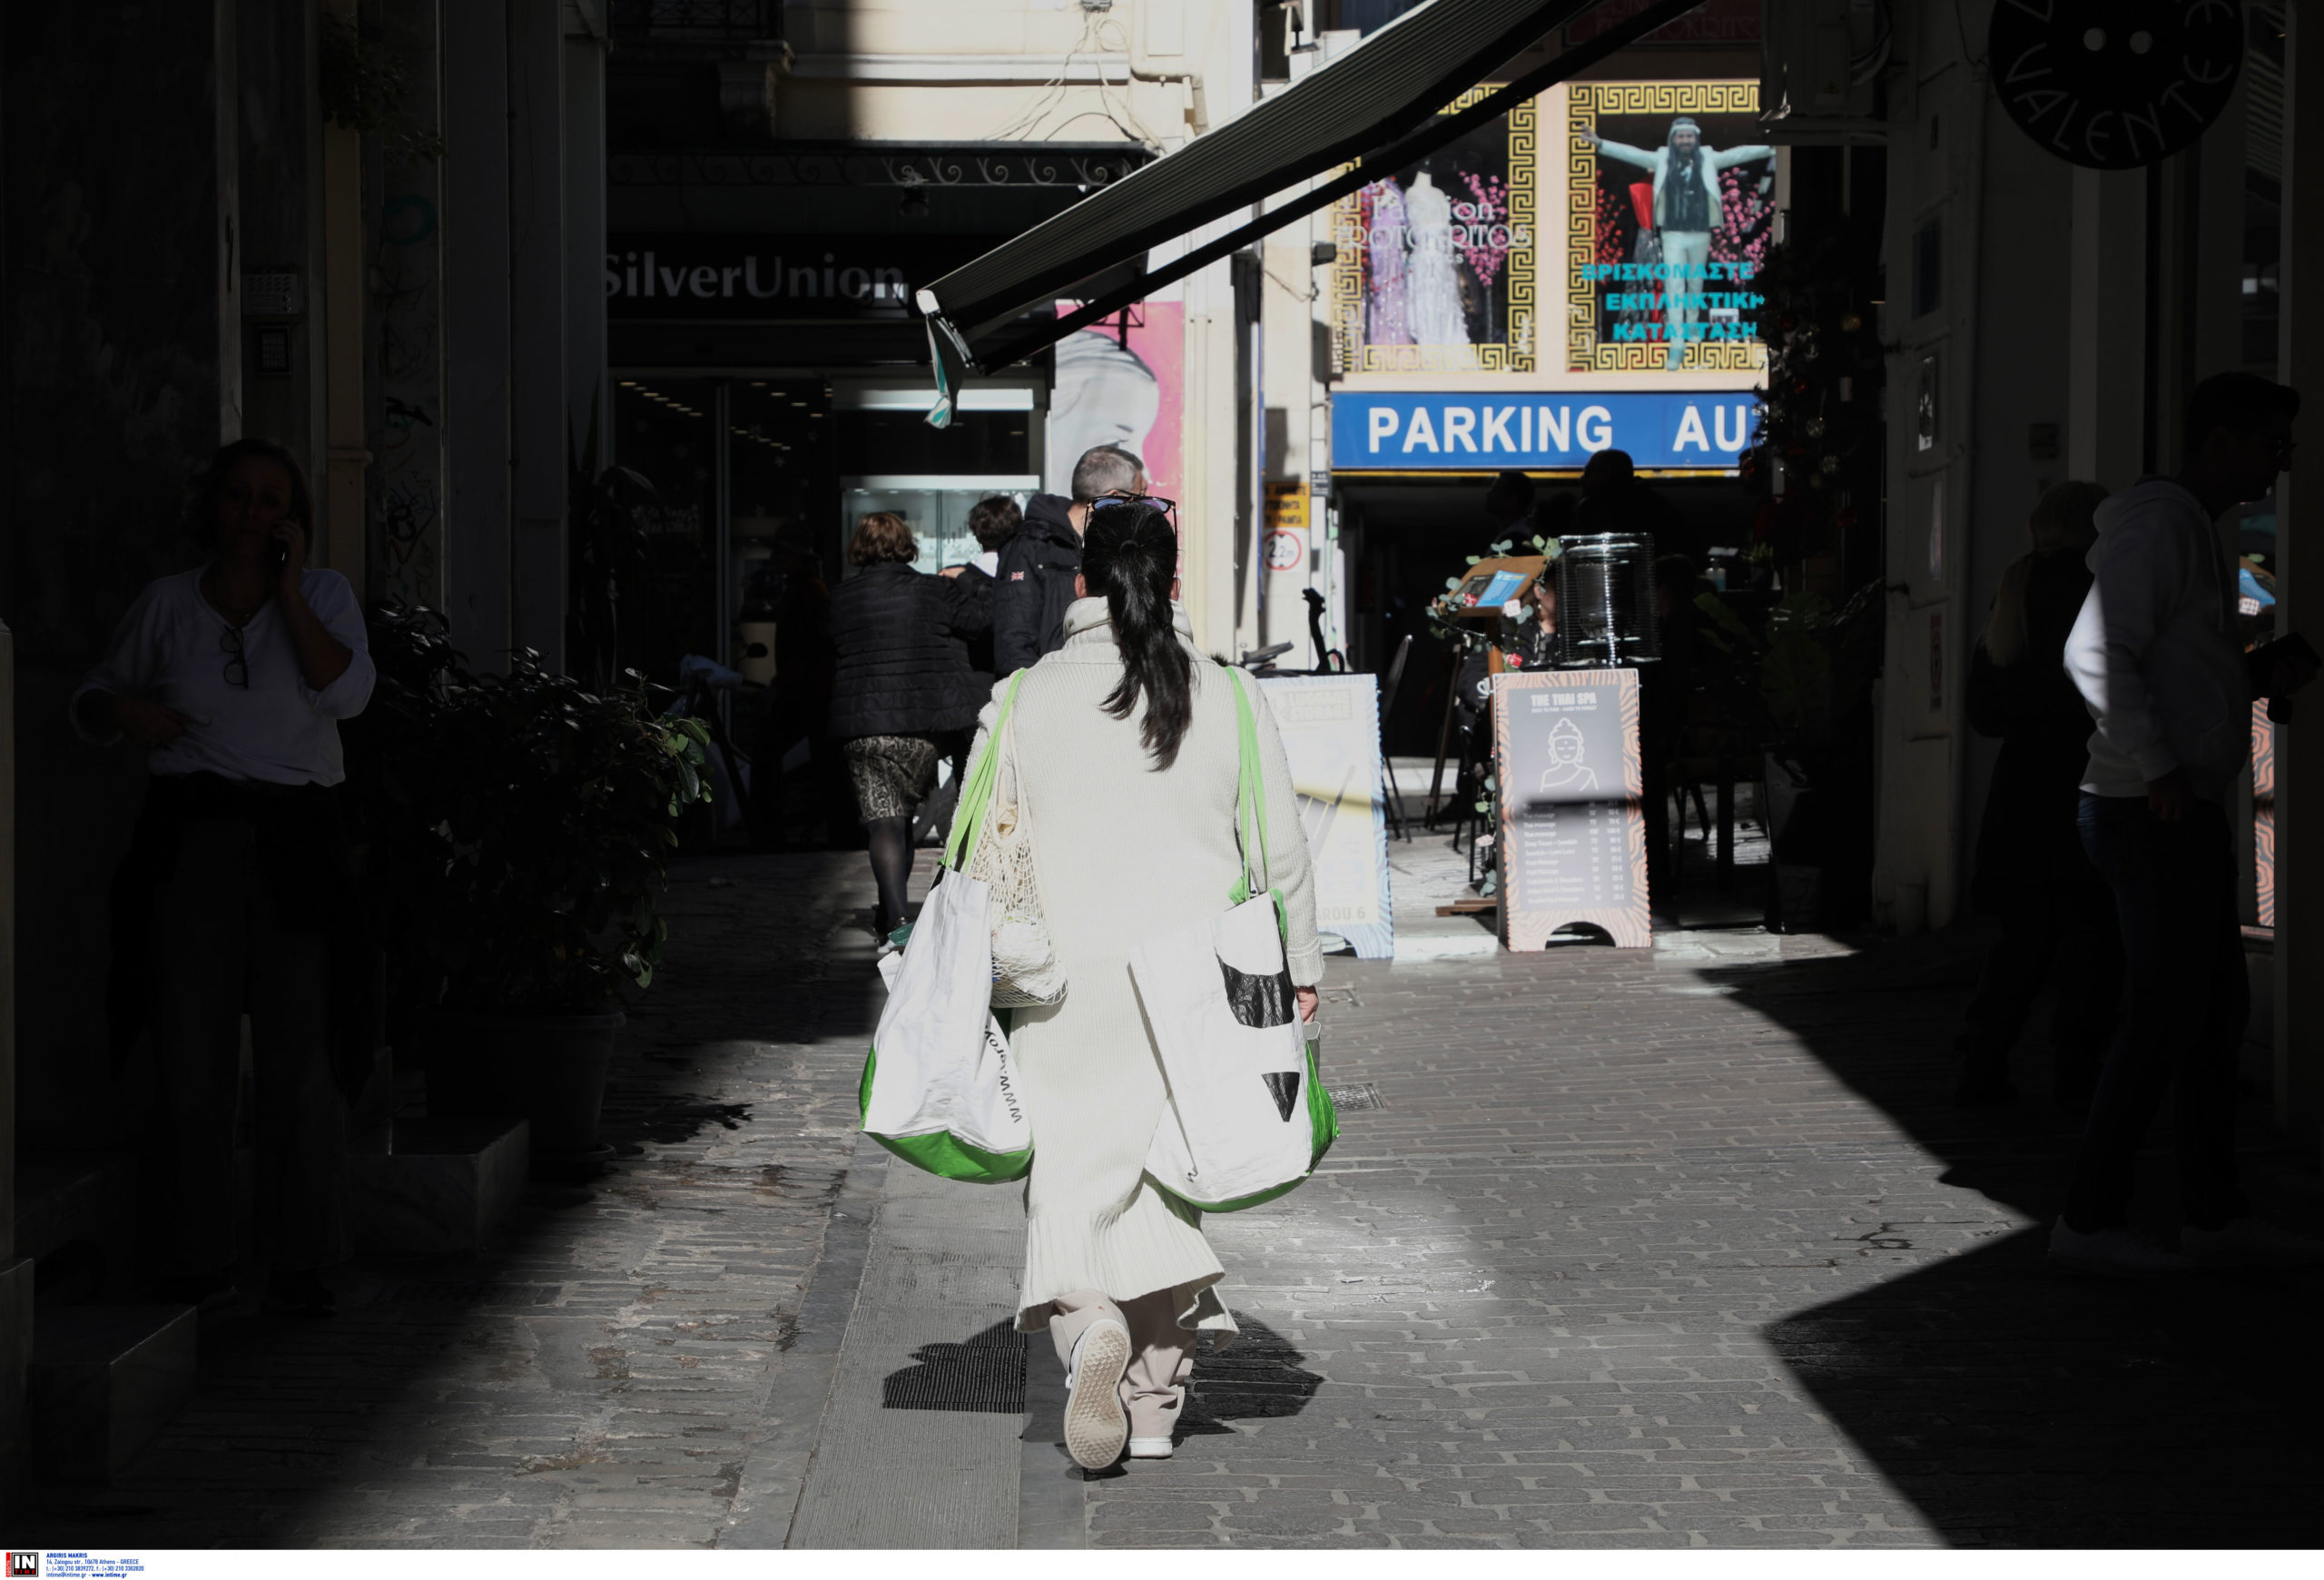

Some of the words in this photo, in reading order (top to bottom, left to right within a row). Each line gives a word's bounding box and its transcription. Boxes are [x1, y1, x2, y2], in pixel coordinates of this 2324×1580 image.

[606, 250, 907, 300] SilverUnion
[1581, 262, 1756, 281] ΒΡΙΣΚΟΜΑΣΤΕ
[1611, 321, 1758, 341] ΚΑΤΑΣΤΑΣΗ
[1367, 405, 1613, 455] PARKING
[1531, 694, 1550, 706] THE
[1551, 693, 1576, 706] THAI
[1576, 692, 1598, 705] SPA
[1357, 905, 1366, 920] 6
